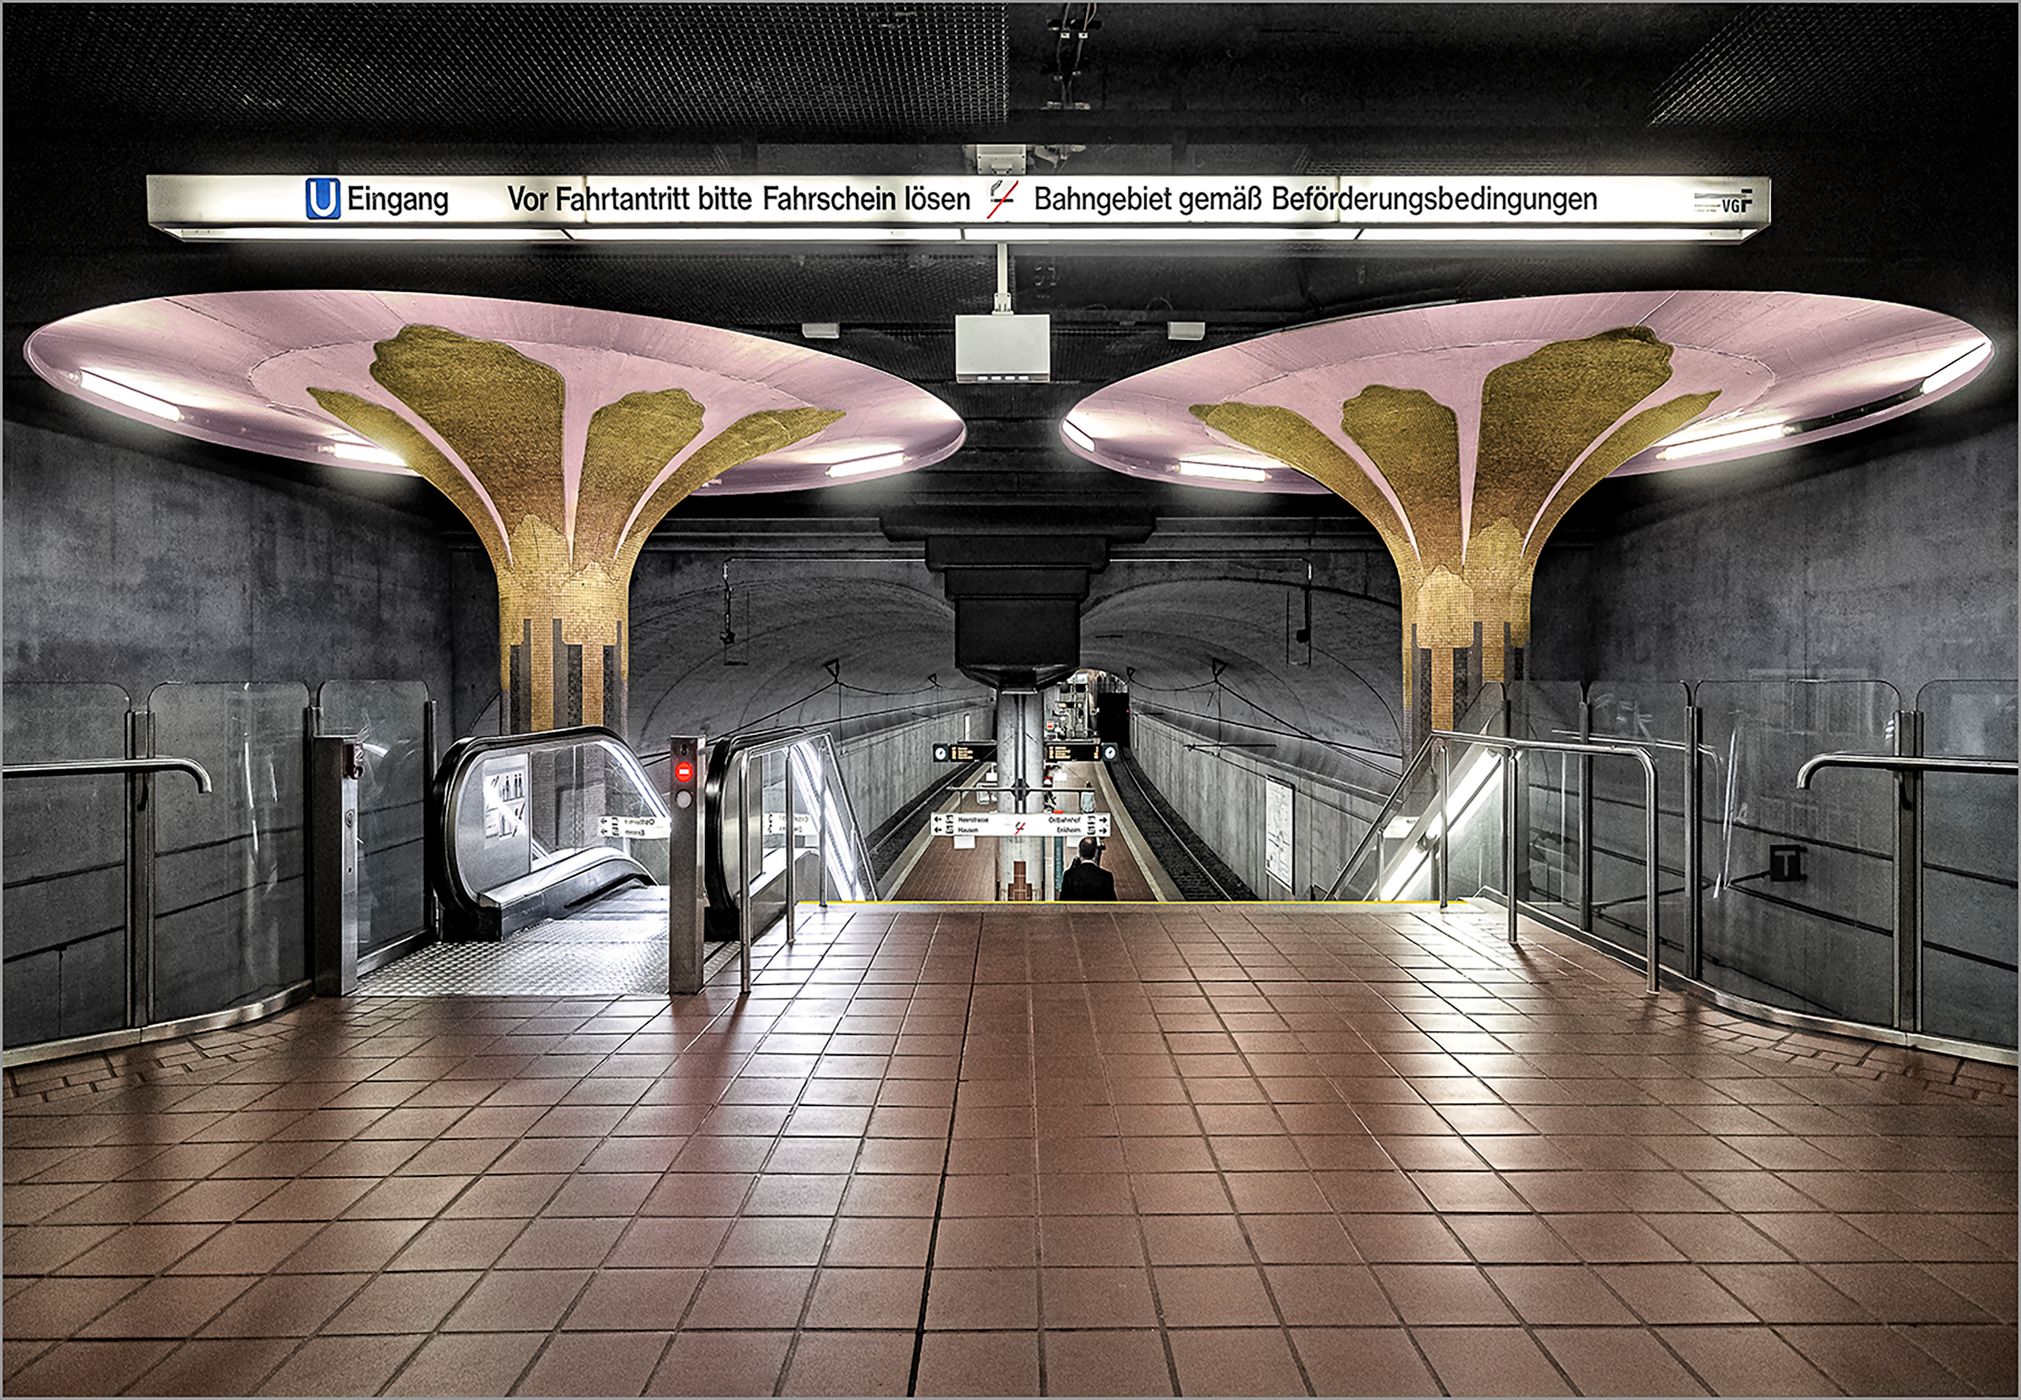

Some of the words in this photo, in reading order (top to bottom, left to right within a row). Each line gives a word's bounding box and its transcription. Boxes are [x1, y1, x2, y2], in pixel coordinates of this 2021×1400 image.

[309, 180, 337, 217] U
[348, 185, 449, 217] Eingang
[507, 185, 548, 212] Vor
[557, 185, 690, 212] Fahrtantritt
[698, 185, 753, 212] bitte
[764, 185, 896, 212] Fahrschein
[905, 185, 970, 212] lösen
[1035, 185, 1172, 217] Bahngebiet
[1179, 185, 1262, 217] gemäß
[1272, 185, 1597, 218] Beförderungsbedingungen
[1721, 188, 1753, 213] VGF
